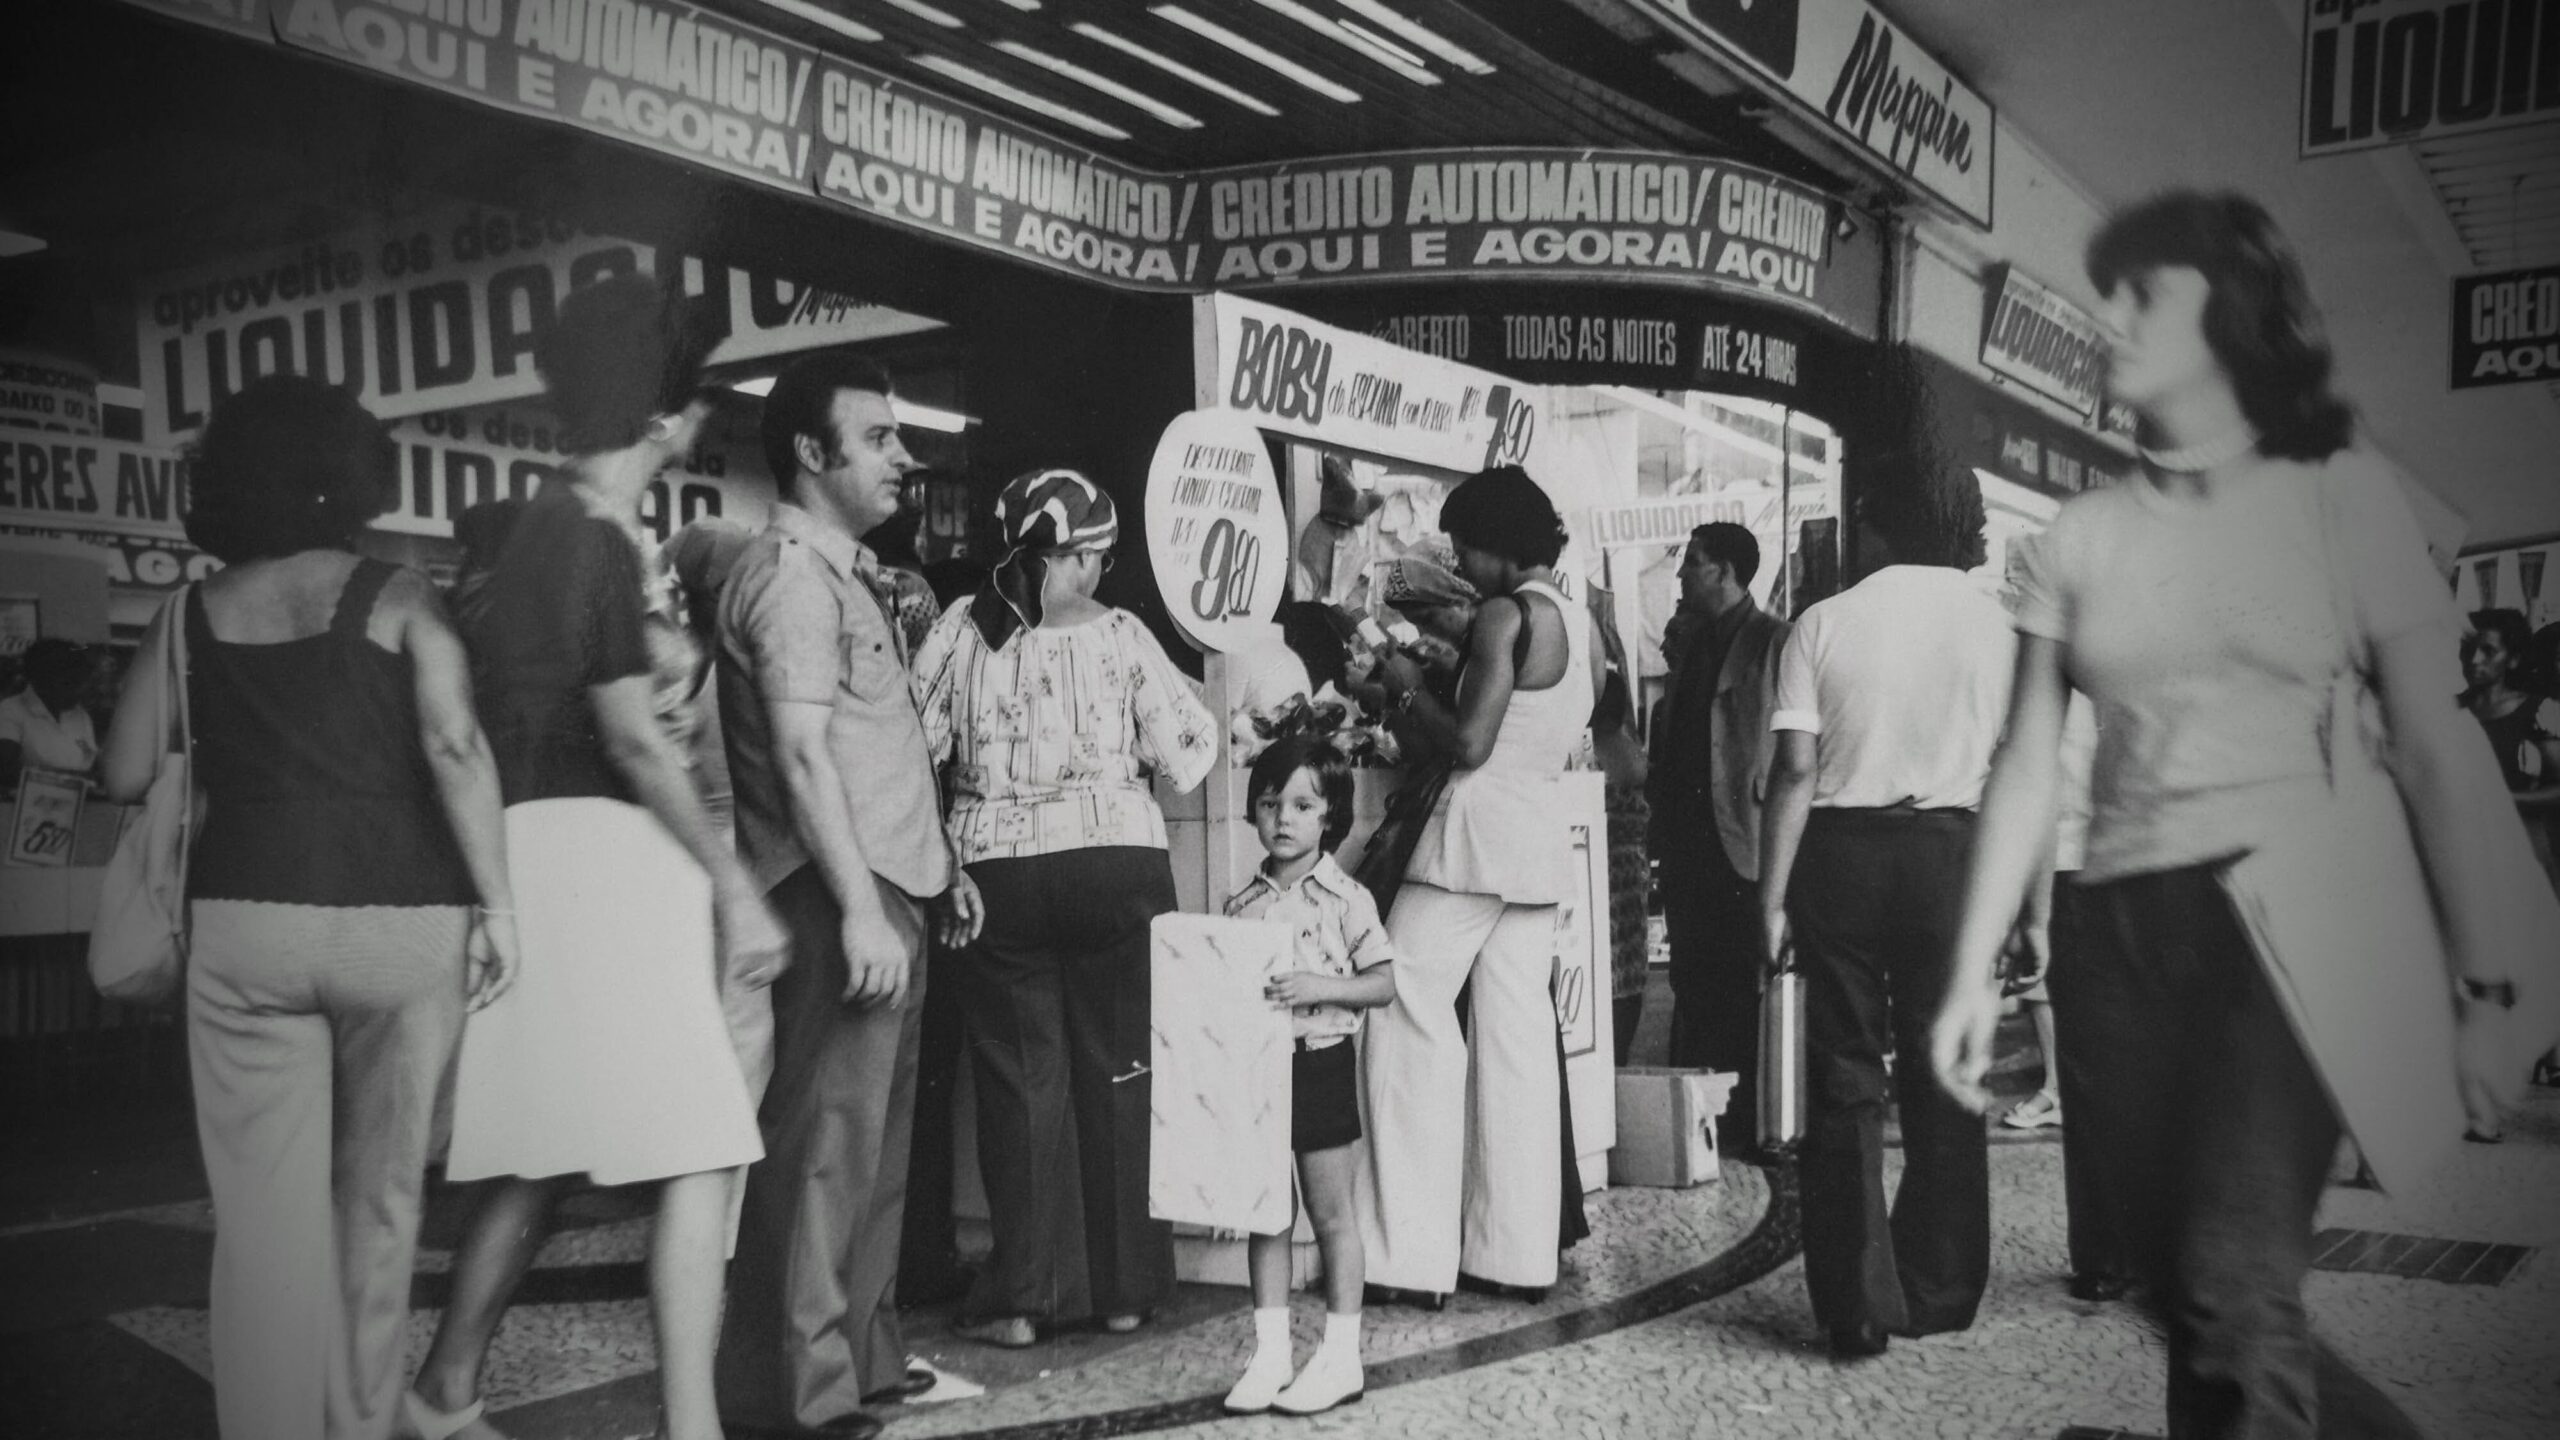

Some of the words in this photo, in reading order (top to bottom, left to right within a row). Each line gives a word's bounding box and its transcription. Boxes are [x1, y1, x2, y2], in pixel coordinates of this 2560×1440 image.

[286, 0, 486, 90] AQUI
[518, 55, 556, 109] E
[1826, 10, 1974, 178] Mappin
[821, 69, 967, 184] CRÉDITO
[824, 150, 956, 227] AQUI
[974, 197, 1003, 239] E
[1210, 164, 1393, 241] CRÉDITO
[1718, 172, 1827, 263] CRÉDITO
[154, 242, 364, 334] aproveite
[382, 232, 434, 277] os
[1215, 234, 1380, 281] AQUI
[1410, 230, 1447, 268] E
[1715, 241, 1816, 298] AQUI
[1230, 316, 1332, 428] BOBY
[1504, 315, 1571, 361] TODAS
[1577, 318, 1607, 362] AS
[1613, 319, 1677, 367] NOITES
[1701, 323, 1731, 373] ATÉ
[1736, 330, 1762, 378] 24
[421, 412, 467, 441] os
